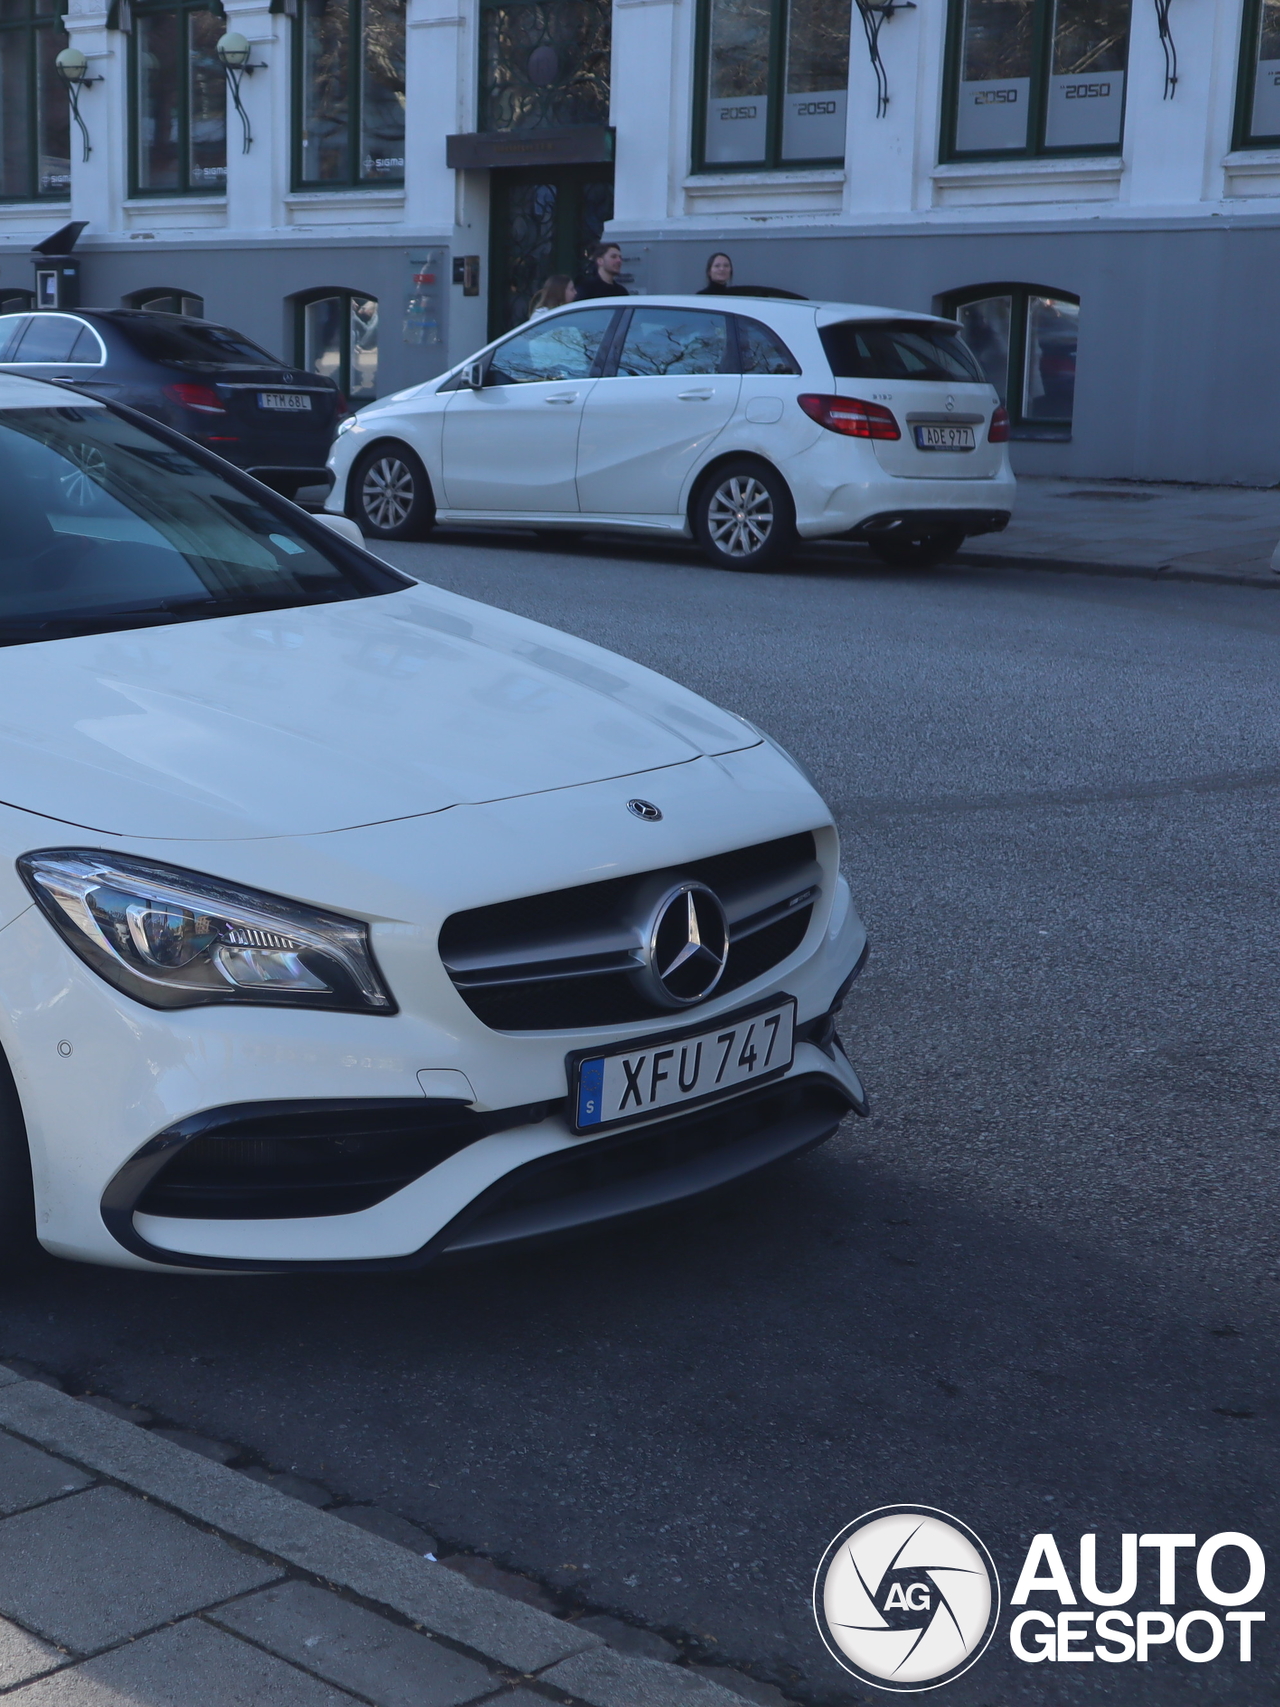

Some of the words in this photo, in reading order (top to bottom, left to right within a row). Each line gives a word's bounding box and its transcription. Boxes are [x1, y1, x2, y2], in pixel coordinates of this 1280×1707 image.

[974, 89, 1018, 105] 2050
[1065, 83, 1111, 99] 2050
[720, 106, 757, 120] 2050
[797, 101, 836, 116] 2050
[288, 395, 308, 408] 68L
[927, 428, 947, 445] ADE
[948, 429, 969, 447] 977
[618, 1041, 703, 1111] XFU
[714, 1013, 782, 1084] 747
[585, 1100, 595, 1114] S
